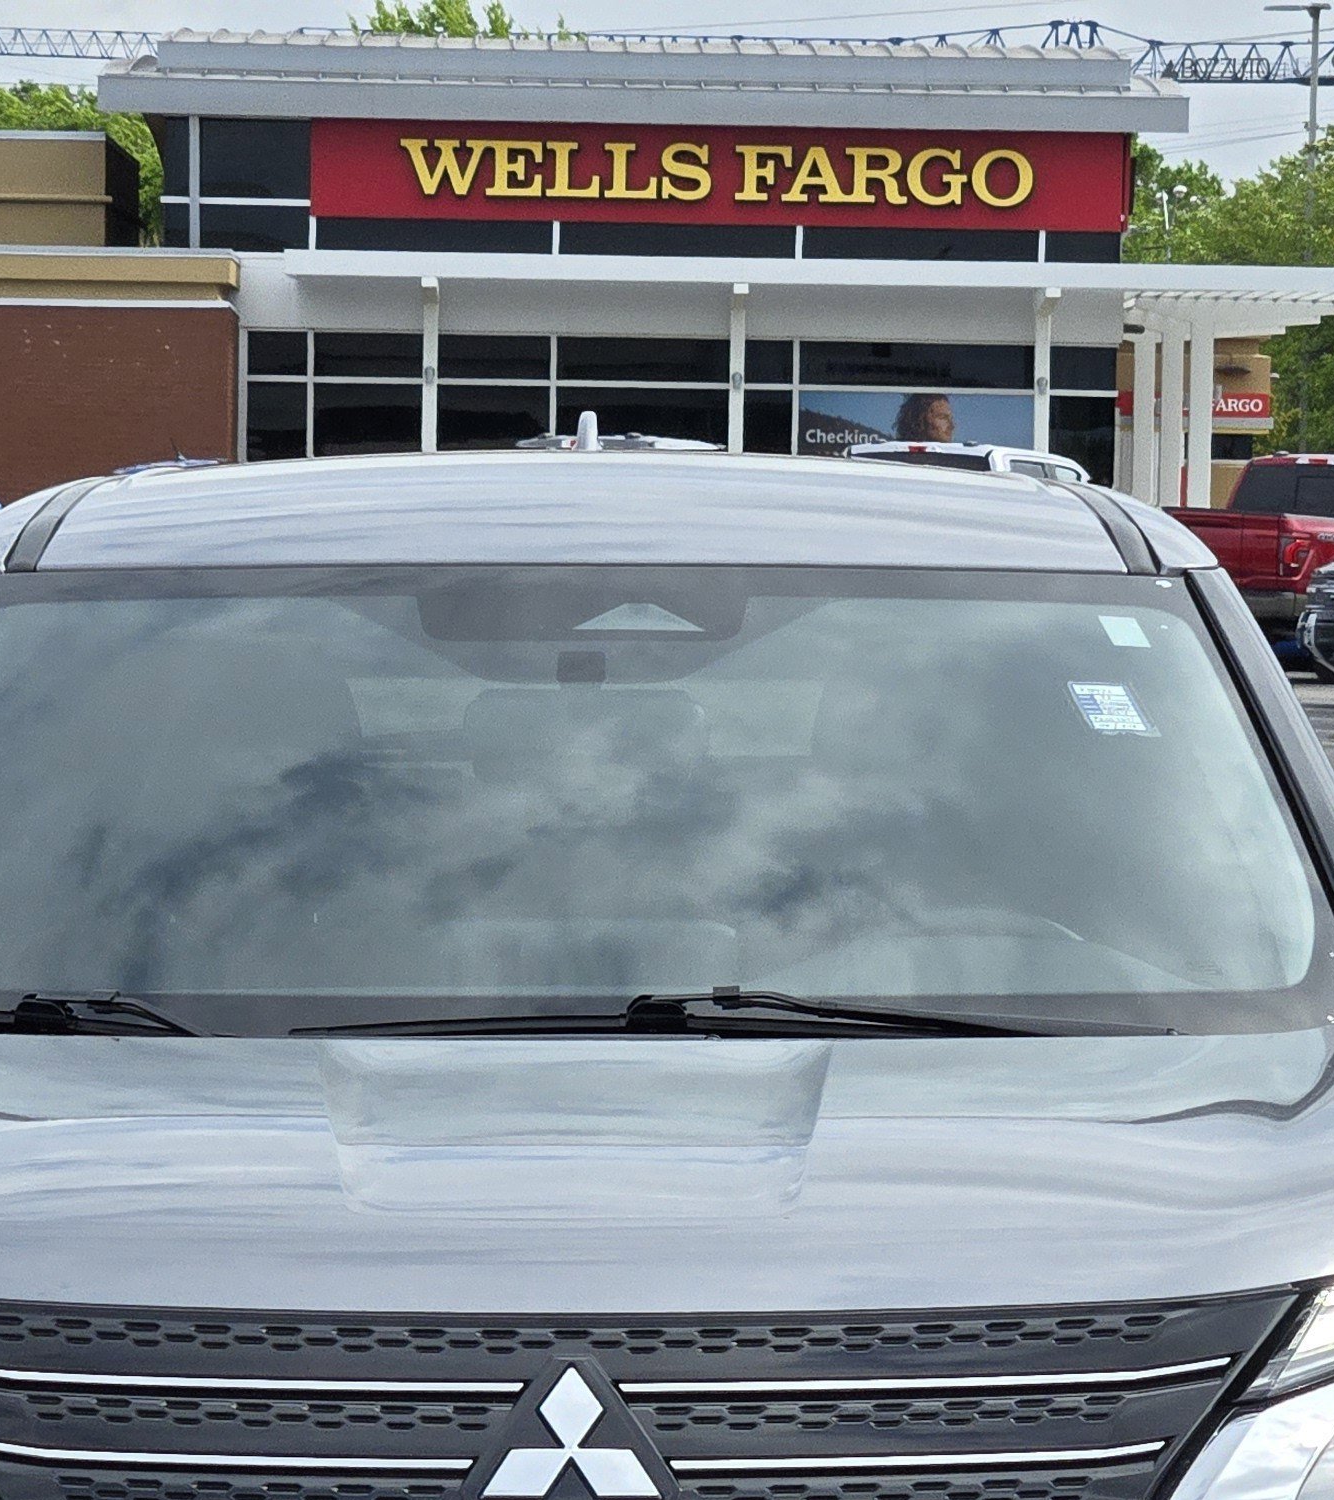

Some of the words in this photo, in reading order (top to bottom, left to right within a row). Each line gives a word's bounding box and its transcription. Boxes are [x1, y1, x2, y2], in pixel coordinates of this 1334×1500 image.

[1181, 57, 1271, 80] BOZZUTO
[399, 138, 712, 201] WELLS
[734, 144, 1035, 207] FARGO
